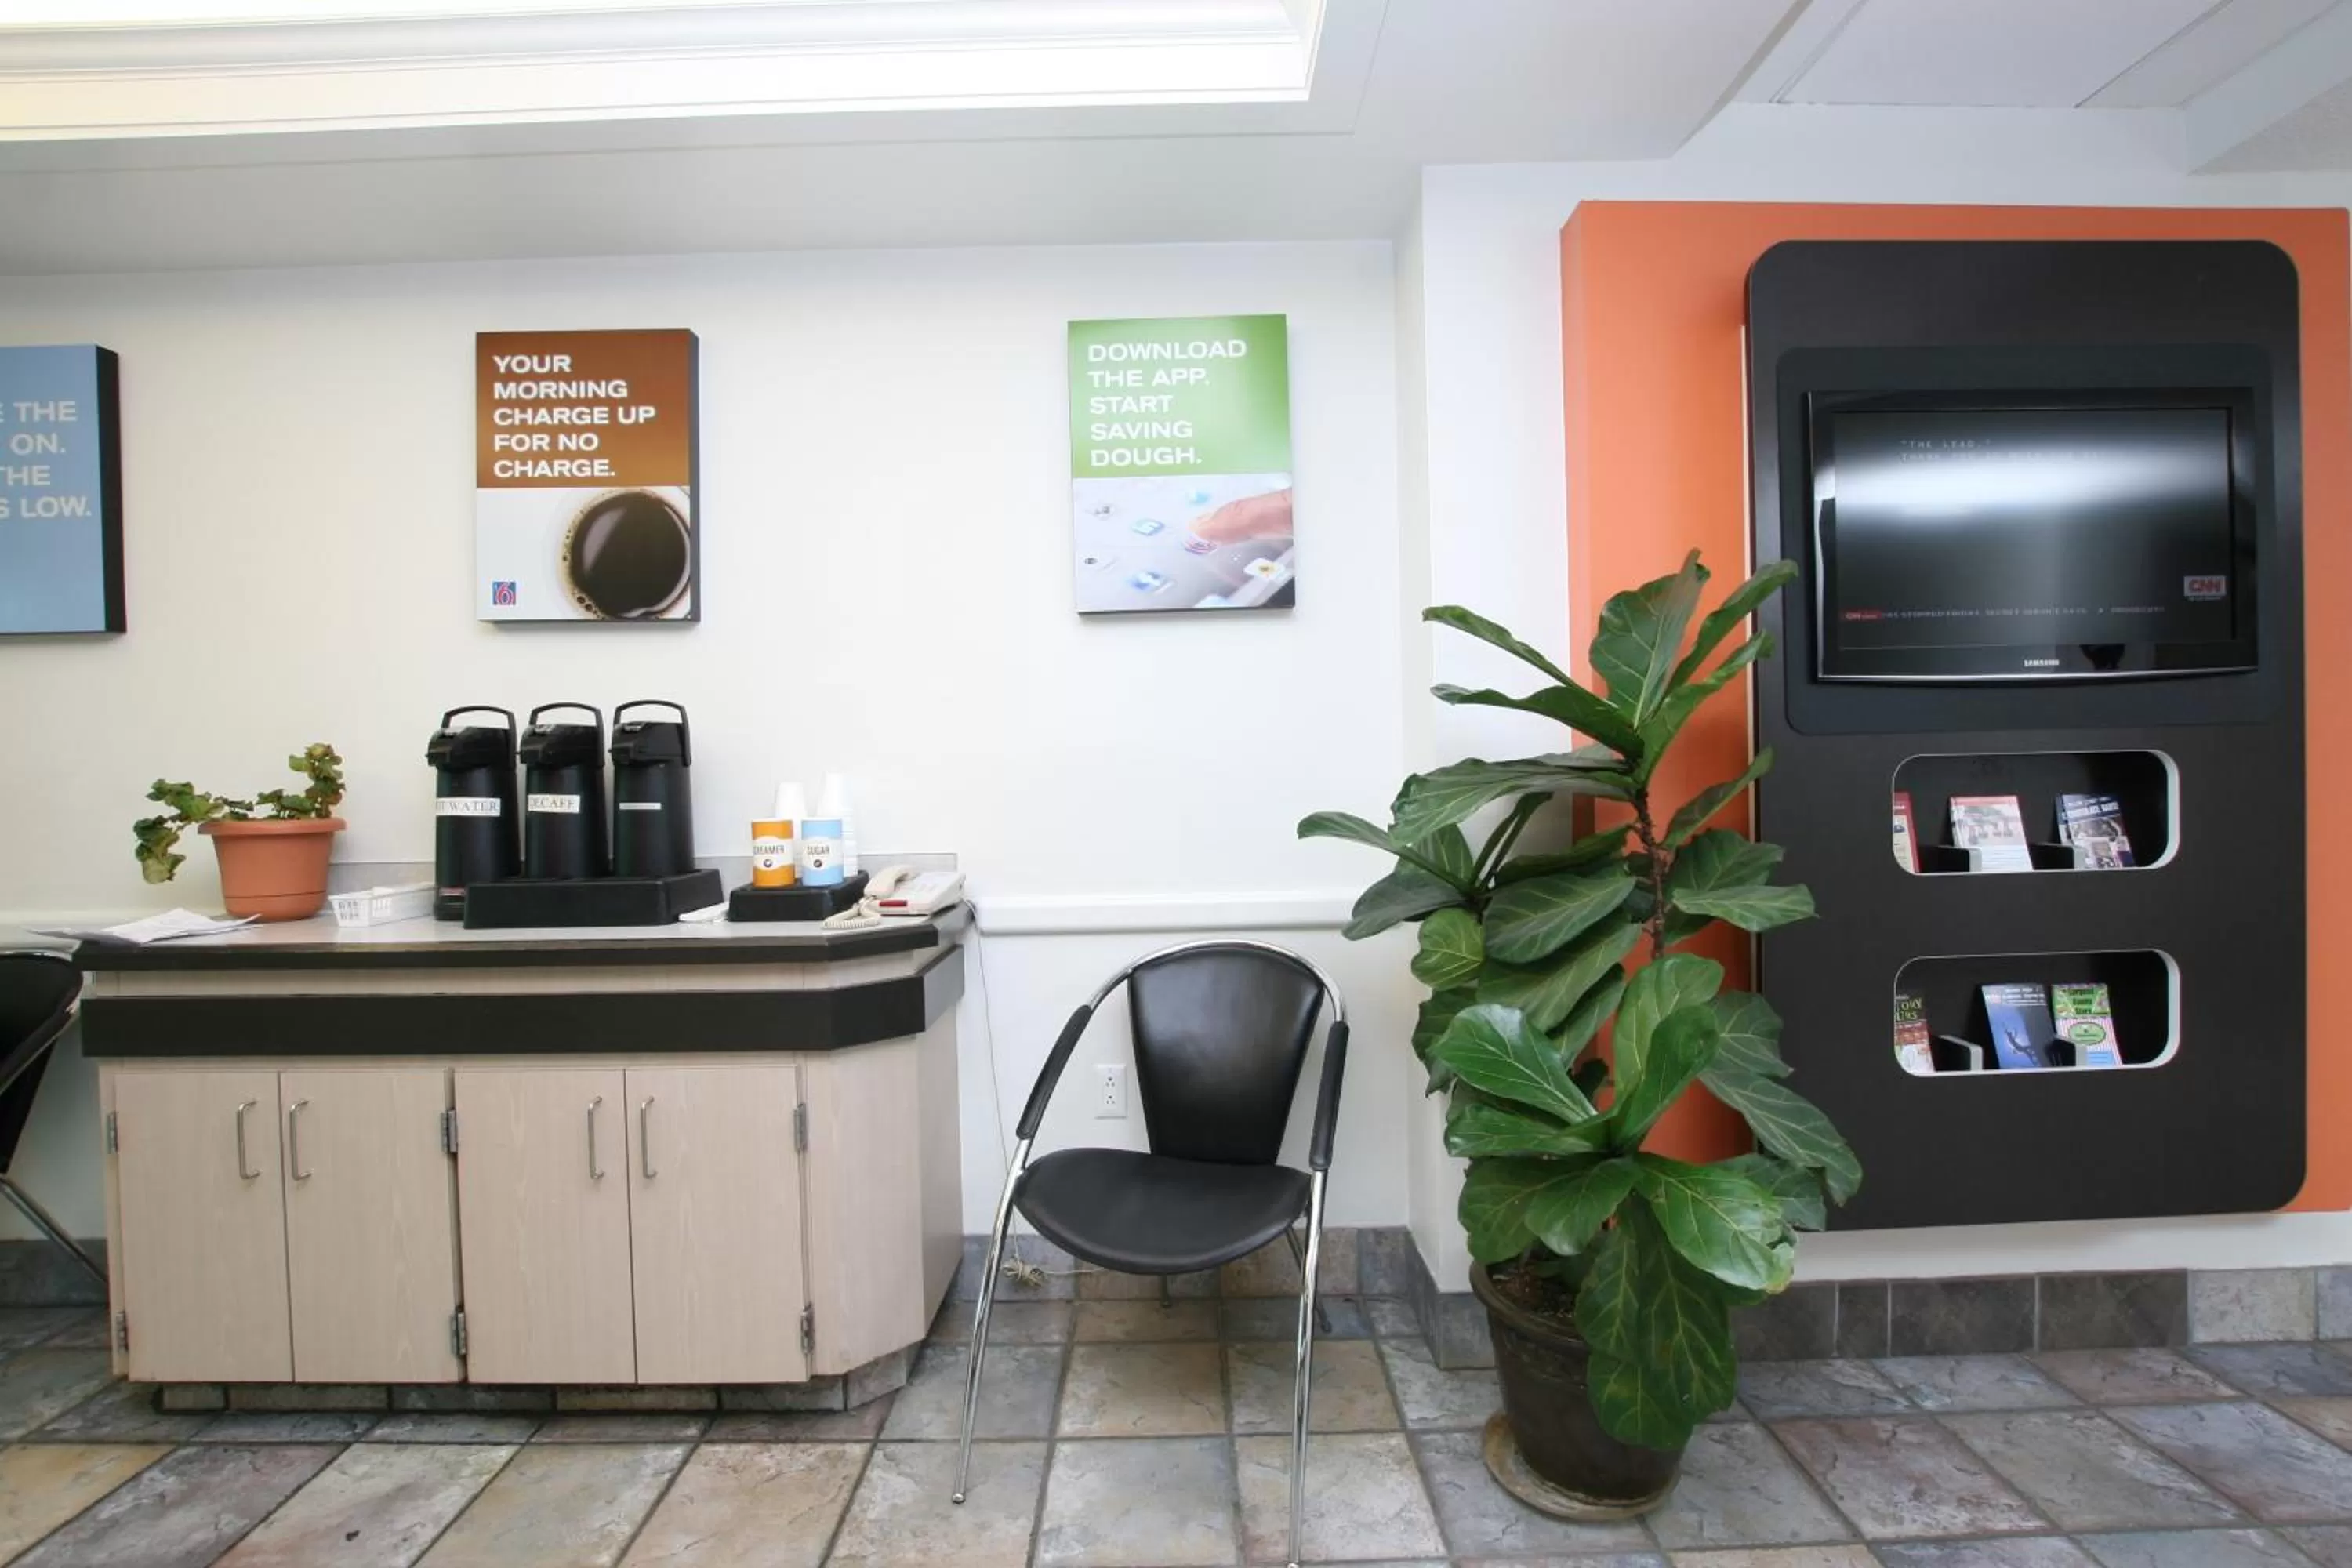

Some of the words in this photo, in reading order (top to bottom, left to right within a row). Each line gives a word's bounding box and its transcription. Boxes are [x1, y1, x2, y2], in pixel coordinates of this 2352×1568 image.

[1087, 340, 1247, 362] DOWNLOAD
[493, 355, 571, 373] YOUR
[1088, 370, 1142, 387] THE
[1152, 368, 1210, 386] APP.
[494, 380, 628, 399] MORNING
[13, 401, 77, 423] THE
[1091, 395, 1173, 414] START
[493, 407, 609, 426] CHARGE
[618, 406, 655, 424] UP
[1091, 421, 1192, 441] SAVING
[10, 434, 66, 455] ON.
[495, 434, 550, 452] FOR
[558, 433, 598, 452] NO
[1091, 448, 1202, 466] DOUGH.
[494, 459, 615, 477] CHARGE.
[20, 496, 92, 518] LOW.
[448, 801, 498, 811] WATER
